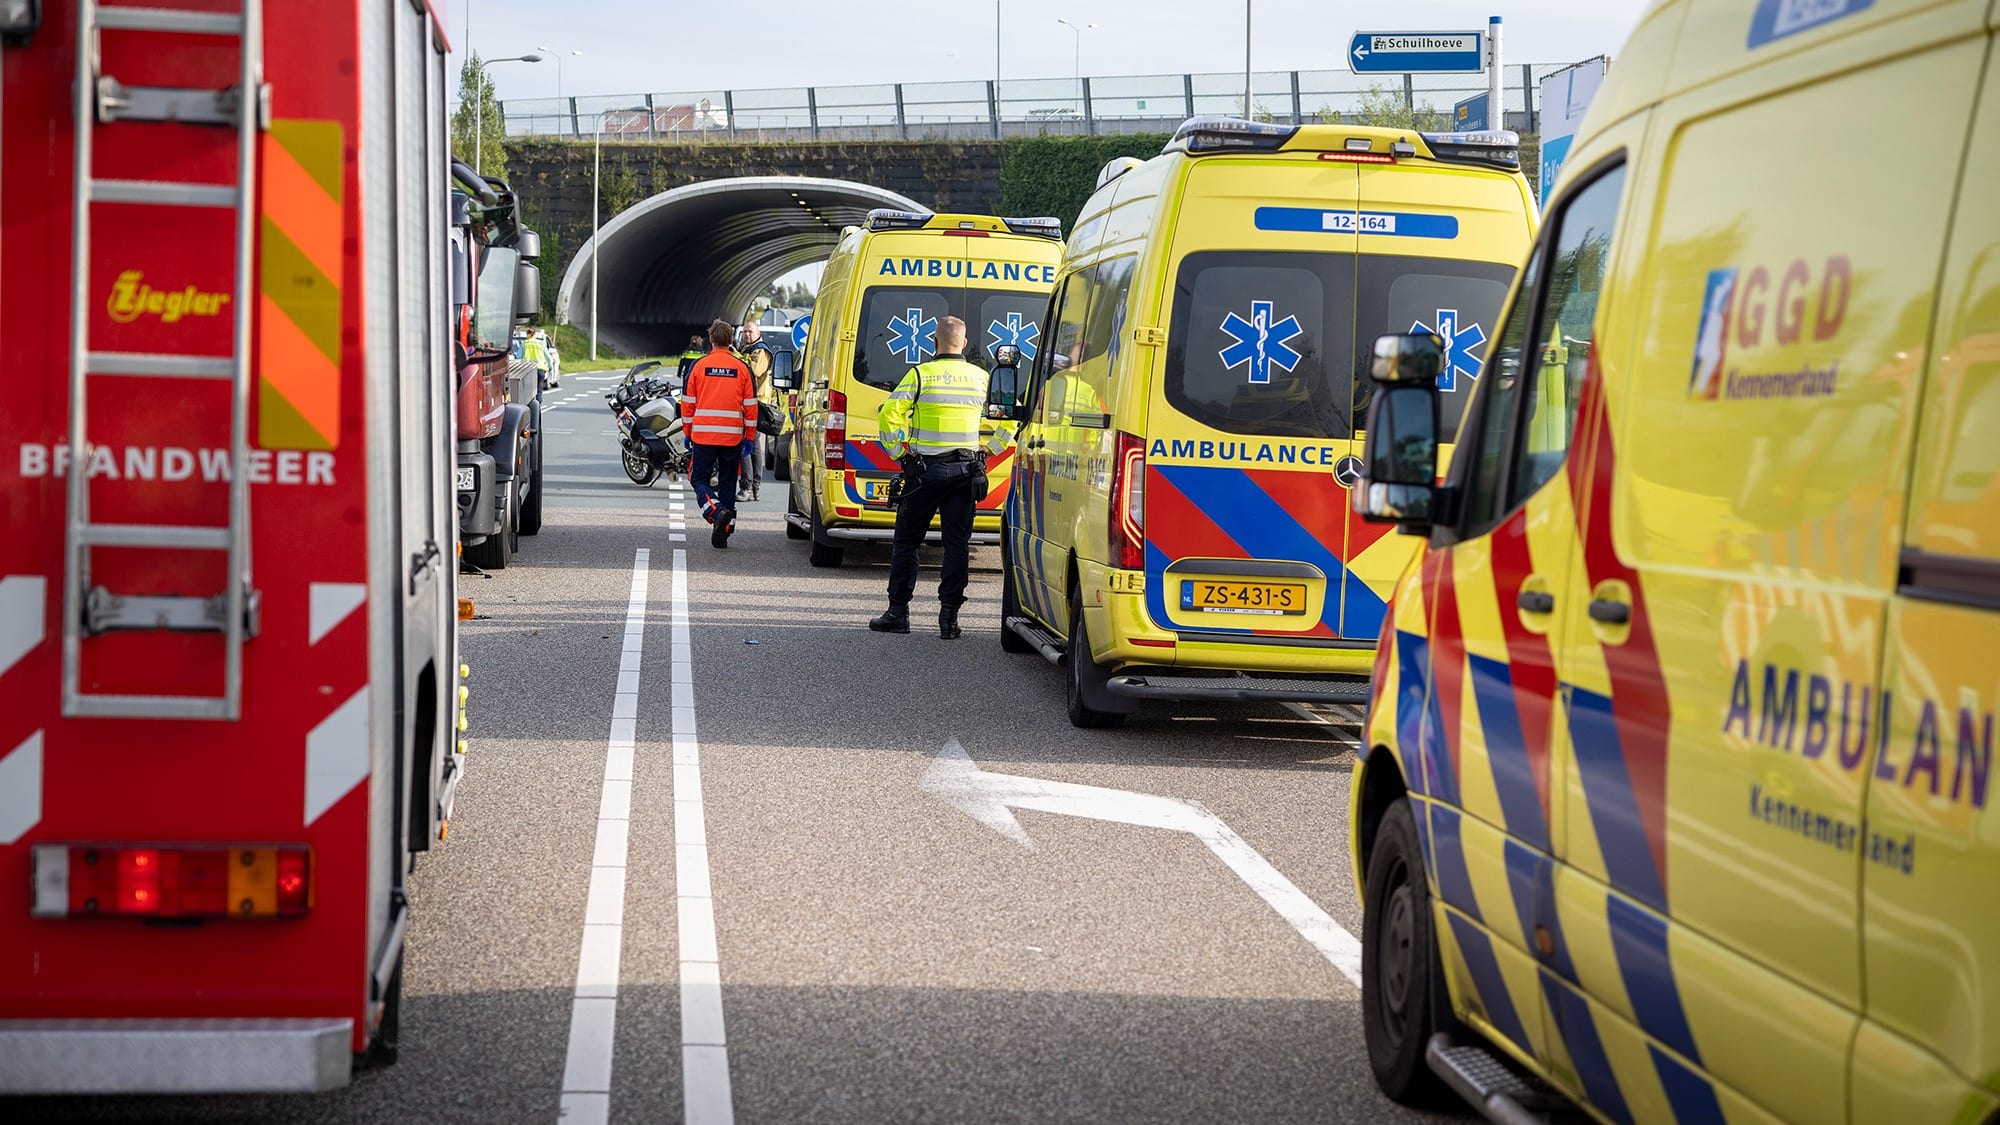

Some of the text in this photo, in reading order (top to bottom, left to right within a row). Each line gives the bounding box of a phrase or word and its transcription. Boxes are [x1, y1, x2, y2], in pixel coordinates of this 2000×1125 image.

[1388, 37, 1463, 49] Schuilhoeve
[1332, 214, 1387, 231] 12-164
[879, 257, 1055, 283] AMBULANCE
[107, 270, 230, 323] Ziegler
[1736, 256, 1851, 349] GGD
[1726, 362, 1837, 400] Kennemerland
[20, 443, 336, 485] BRANDWEER
[1149, 439, 1333, 465] AMBULANCE
[1203, 586, 1292, 606] ZS-431-S
[1723, 658, 1994, 810] AMBULAN
[1749, 783, 1915, 876] Kennemerland
